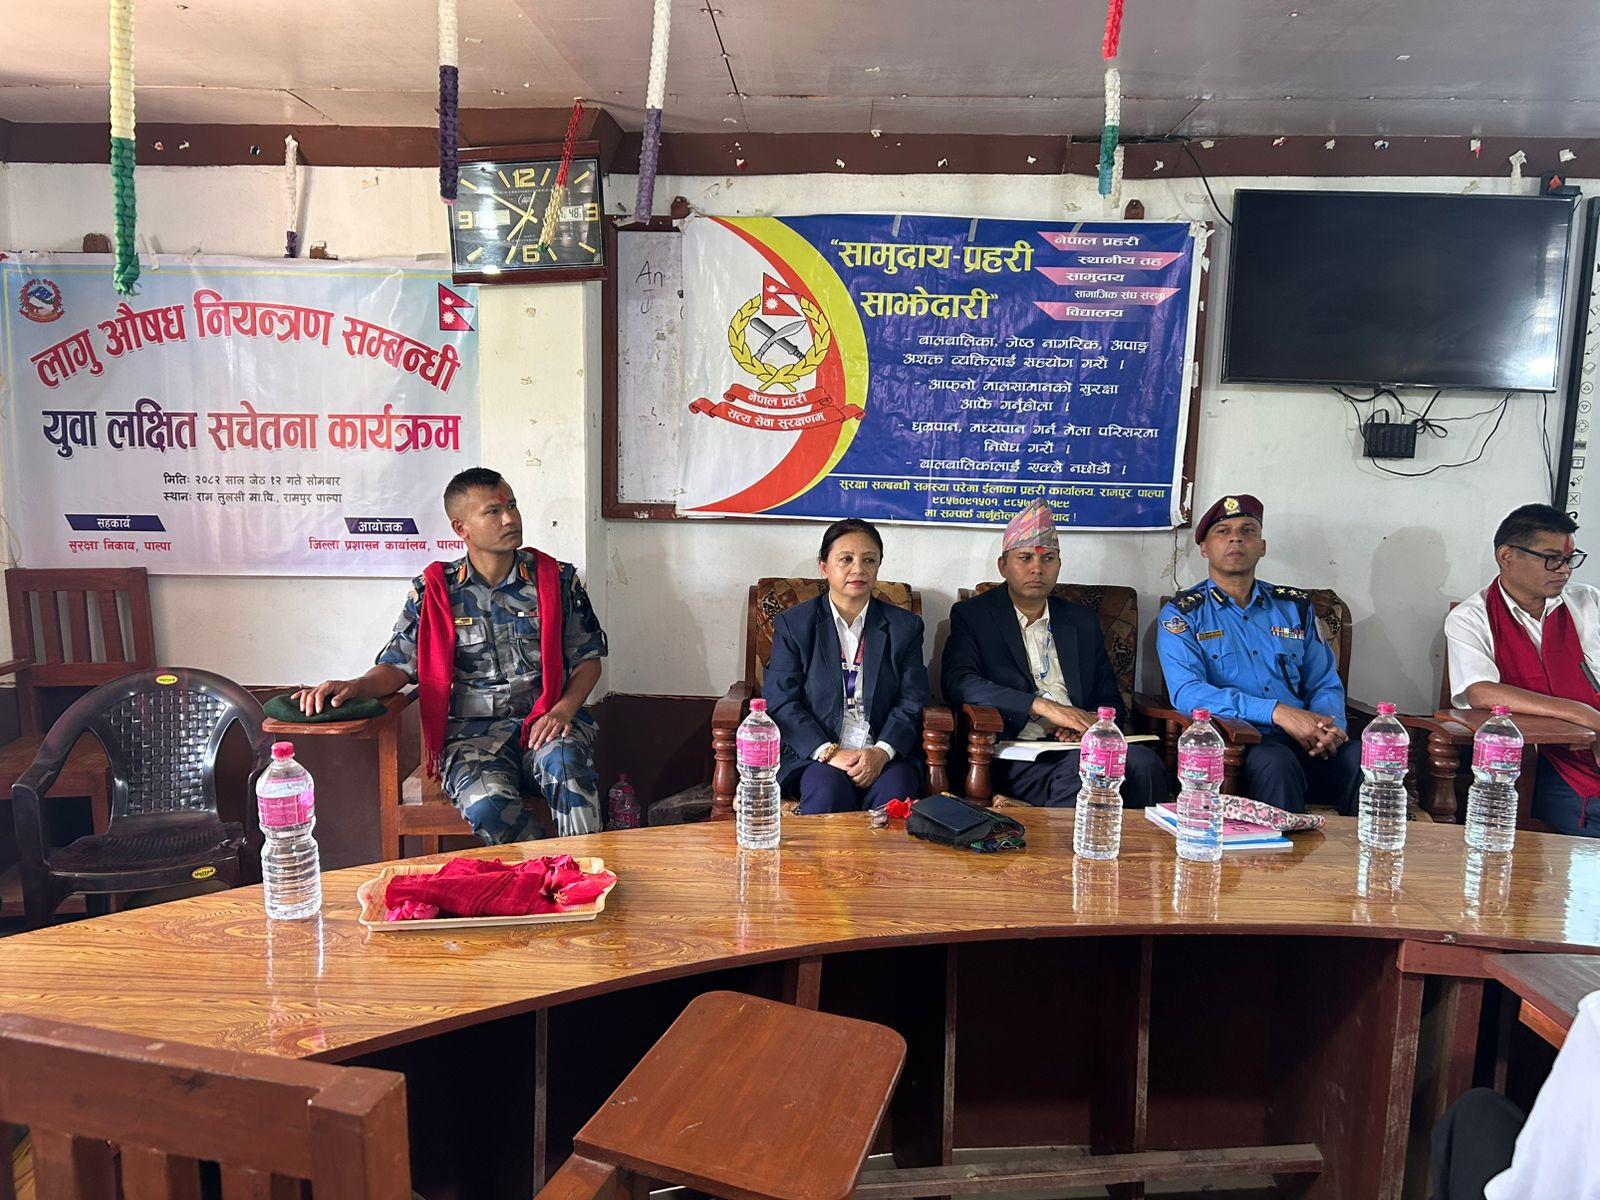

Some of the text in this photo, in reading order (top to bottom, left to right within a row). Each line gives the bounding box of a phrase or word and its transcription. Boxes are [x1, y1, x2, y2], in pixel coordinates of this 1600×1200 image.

[512, 168, 536, 188] 12
[458, 210, 473, 229] 9
[583, 203, 598, 222] 3
[1054, 236, 1140, 247] नेपाल प्रहरी
[522, 244, 540, 263] 6
[1078, 254, 1163, 267] स्थानीय तह
[1066, 272, 1125, 283] सामुदाय
[1074, 289, 1117, 299] सामाजिक
[1121, 289, 1137, 299] संघ
[1066, 305, 1124, 317] विद्यालय
[31, 289, 461, 392] लागु औषध नियन्त्रण सम्बन्धी
[902, 353, 945, 365] अशक्त
[951, 353, 1017, 367] व्यक्तिलाई
[1023, 355, 1074, 368] सहयोग
[983, 381, 1072, 393] मालसामानको
[1080, 383, 1120, 397] सुरक्षा
[748, 392, 808, 406] नेपाल प्रहरी
[728, 409, 751, 423] सत्य
[755, 415, 774, 427] सेवा
[42, 398, 461, 458] युवा लक्षित सचेतना कार्यक्रम
[1033, 422, 1056, 435] गर्न
[1063, 423, 1092, 436] मेला
[1098, 423, 1159, 438] परिसरमा
[984, 439, 1021, 452] निषेध
[920, 457, 1021, 472] बालबालिकालाई
[195, 475, 220, 485] २०८२
[225, 475, 245, 485] साल
[250, 473, 266, 485] जेठ
[270, 476, 281, 485] १२
[286, 473, 302, 486] गते
[839, 480, 868, 491] सुरक्षा
[871, 480, 910, 491] सम्बन्धी
[914, 482, 949, 492] समस्या
[1020, 484, 1046, 496] प्रहरी
[1137, 489, 1165, 498] पाल्पा
[196, 492, 213, 501] राम
[217, 490, 245, 505] तुलसी
[283, 493, 312, 506] रामपुर
[316, 493, 342, 503] पाल्पा
[924, 509, 937, 518] मा
[940, 508, 974, 519] सम्पर्क
[97, 515, 131, 529] सहकार्य
[358, 519, 403, 533] आयोजक
[68, 541, 99, 553] सुरक्षा
[144, 541, 171, 551] पाल्पा
[309, 537, 340, 550] जिल्ला
[345, 540, 380, 551] प्रशासन
[436, 540, 465, 550] पाल्पा
